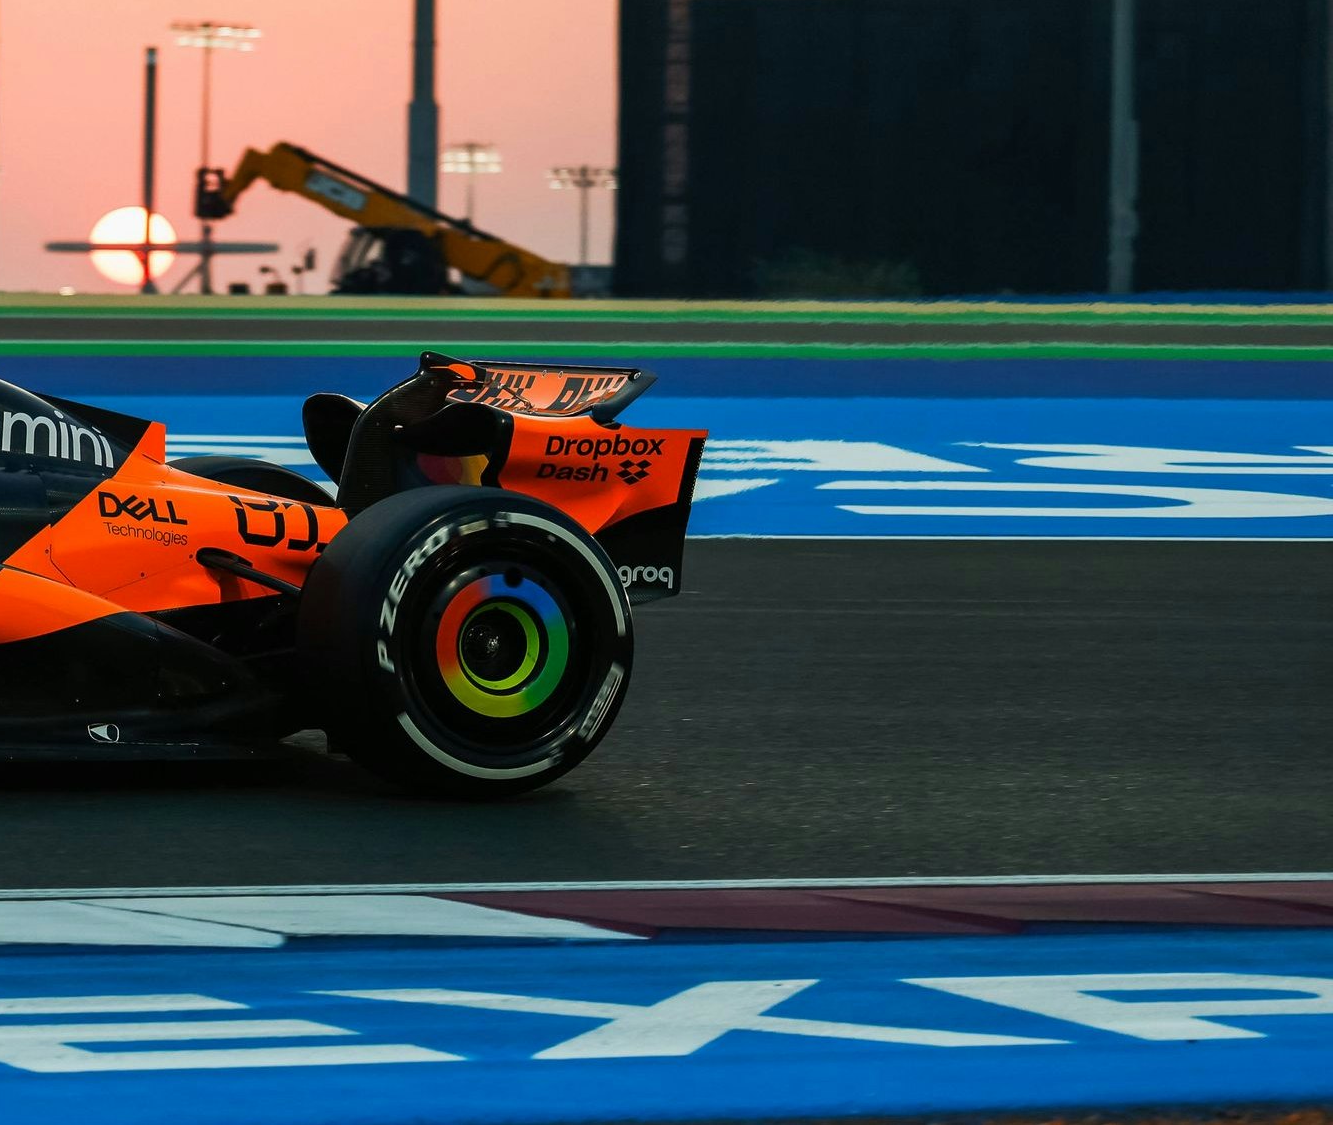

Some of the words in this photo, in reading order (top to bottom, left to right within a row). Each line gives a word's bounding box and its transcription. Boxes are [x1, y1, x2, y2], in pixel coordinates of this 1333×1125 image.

[544, 433, 667, 460] Dropbox
[536, 462, 609, 482] Dash
[98, 491, 188, 525] DELL
[102, 521, 188, 546] Technologies
[379, 524, 450, 637] ZERO
[617, 565, 674, 589] groq
[377, 640, 395, 674] P
